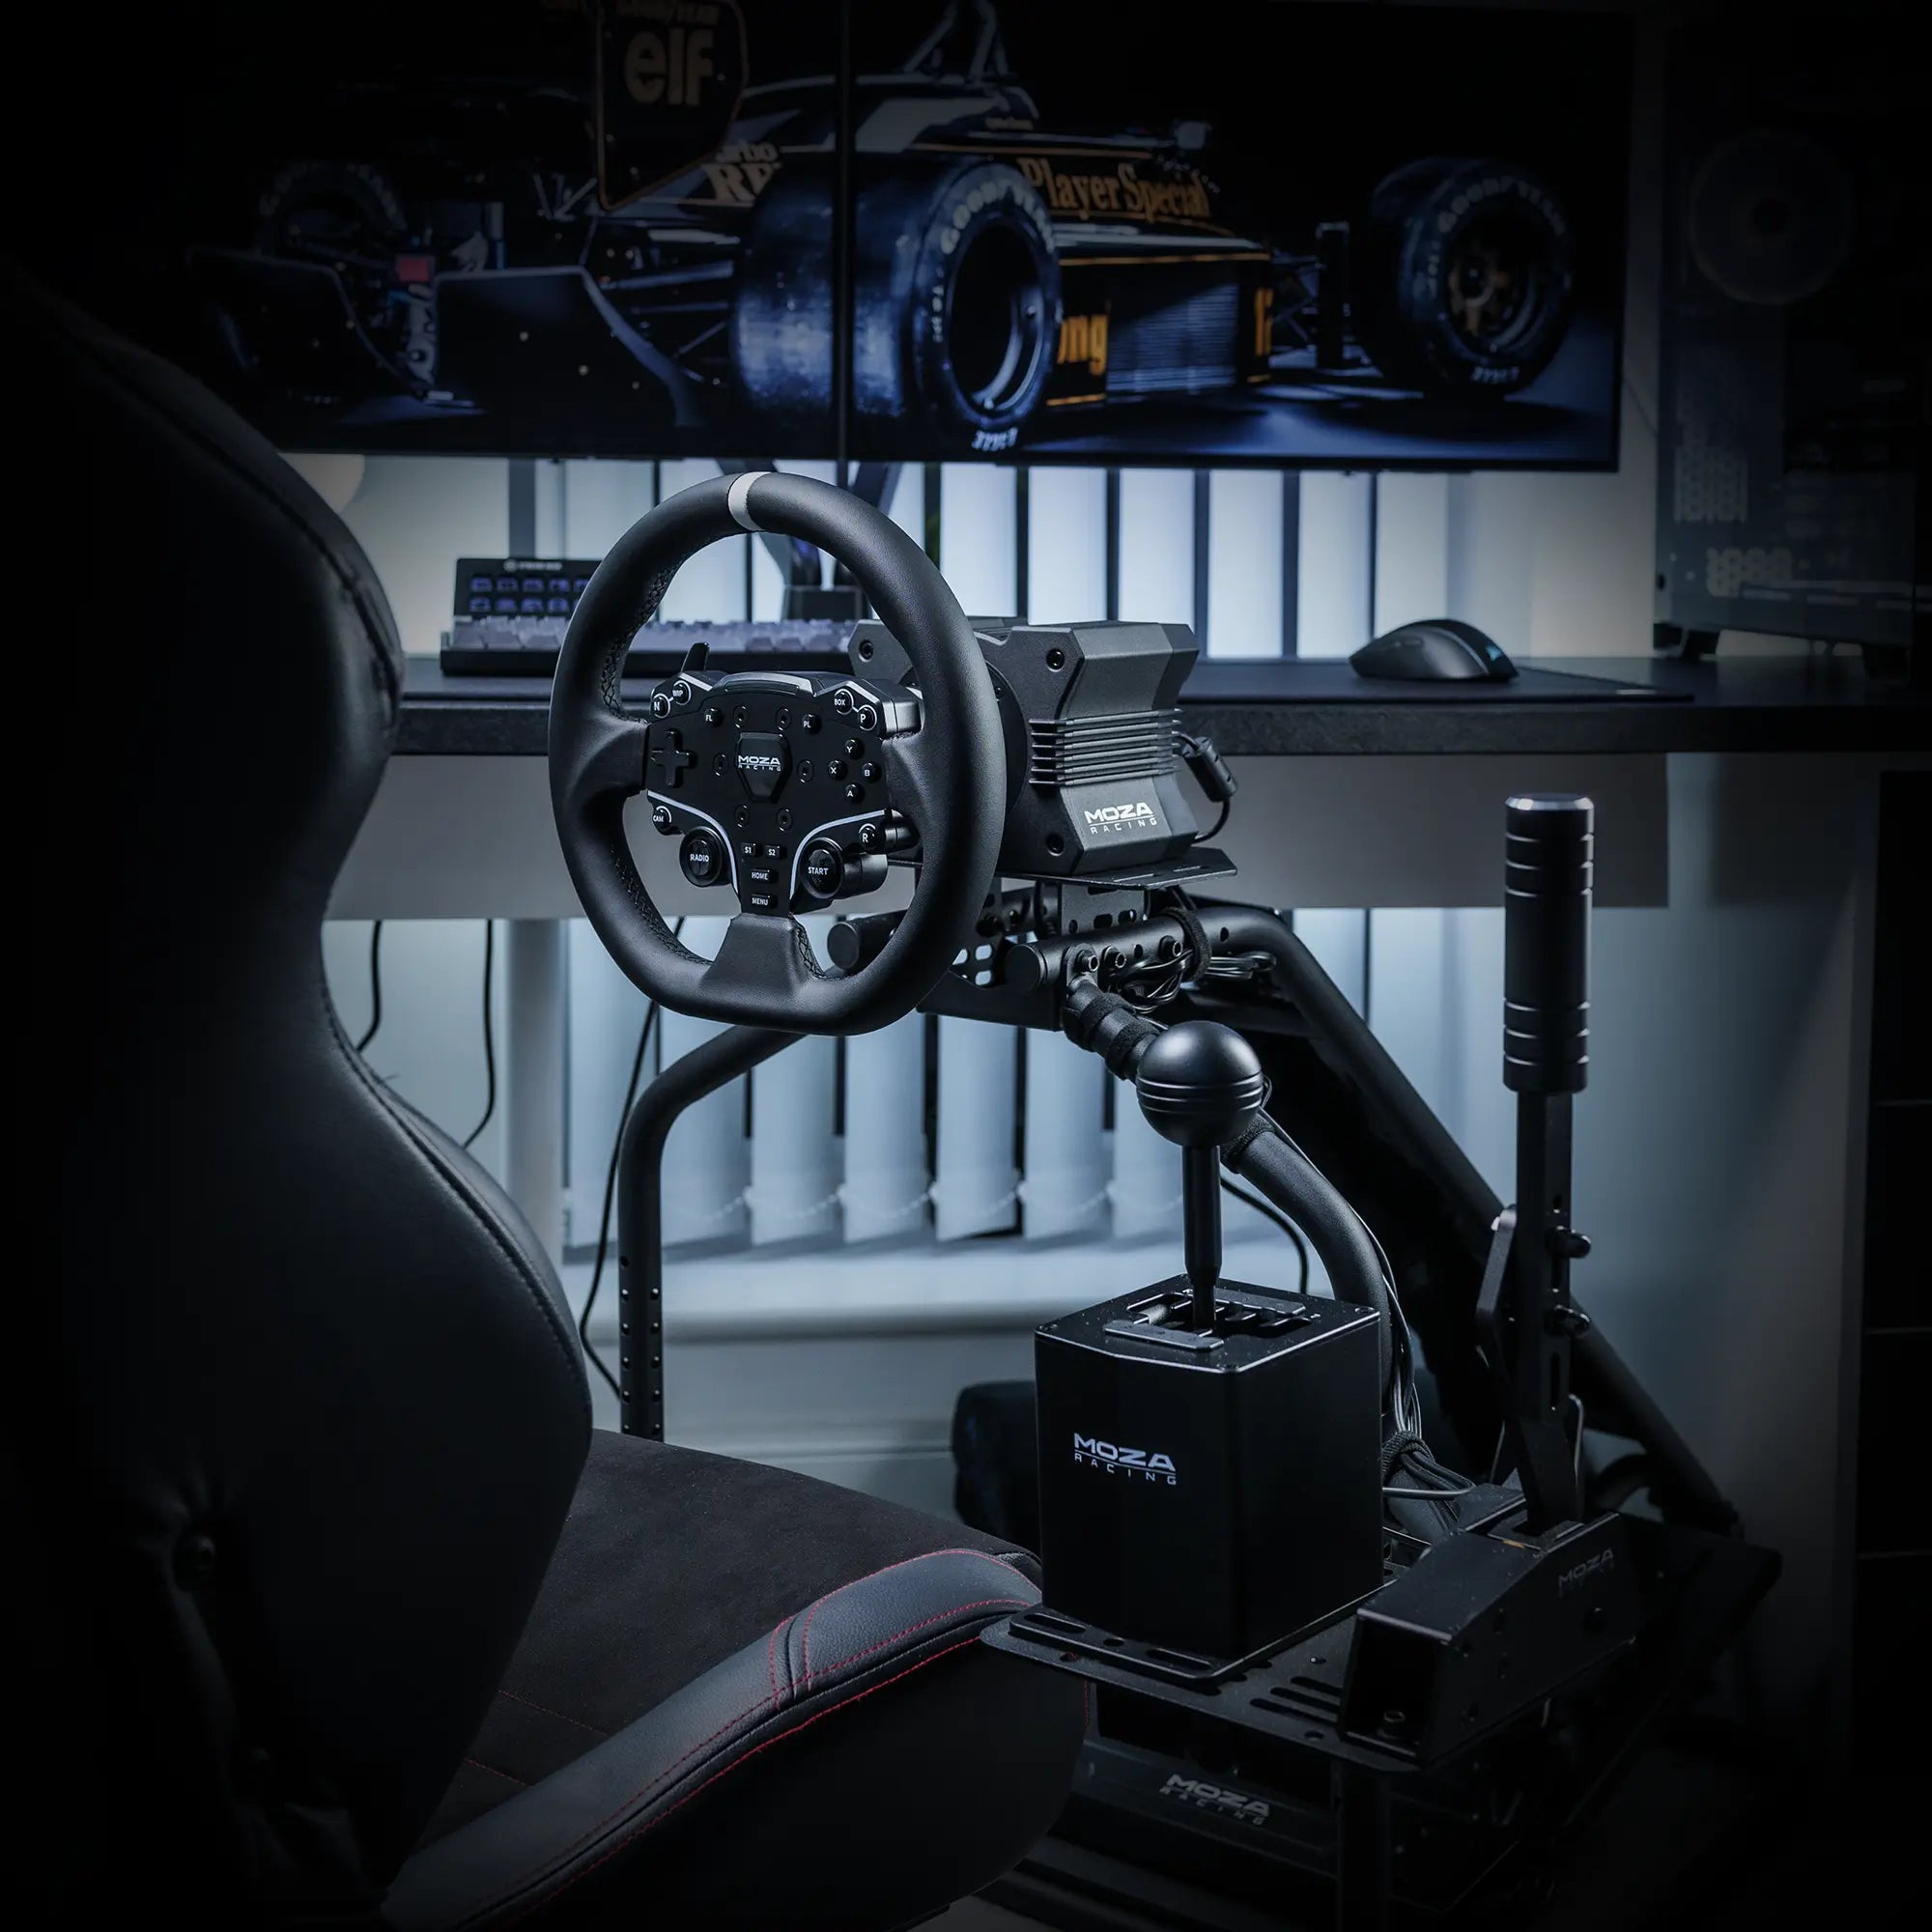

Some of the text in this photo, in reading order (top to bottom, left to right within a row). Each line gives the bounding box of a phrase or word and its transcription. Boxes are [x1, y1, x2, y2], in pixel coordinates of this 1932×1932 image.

[621, 26, 715, 107] elf
[1015, 156, 1121, 221] Player
[653, 701, 661, 712] N
[834, 697, 846, 706] BOX
[803, 720, 811, 728] PL
[859, 713, 867, 724] P
[738, 754, 781, 765] MOZA
[830, 766, 837, 775] X
[846, 789, 854, 798] A
[652, 813, 665, 823] CAM
[1084, 802, 1153, 824] MOZA
[1090, 817, 1157, 835] RACING
[862, 832, 868, 843] R
[690, 853, 710, 863] RADIO
[768, 848, 776, 857] S2
[751, 871, 769, 880] HOME
[808, 866, 829, 875] START
[752, 896, 769, 906] MENU
[1073, 1432, 1177, 1472] MOZA
[1074, 1452, 1177, 1486] RACING
[1557, 1548, 1615, 1586] MOZA
[1166, 1774, 1270, 1817] MOZA
